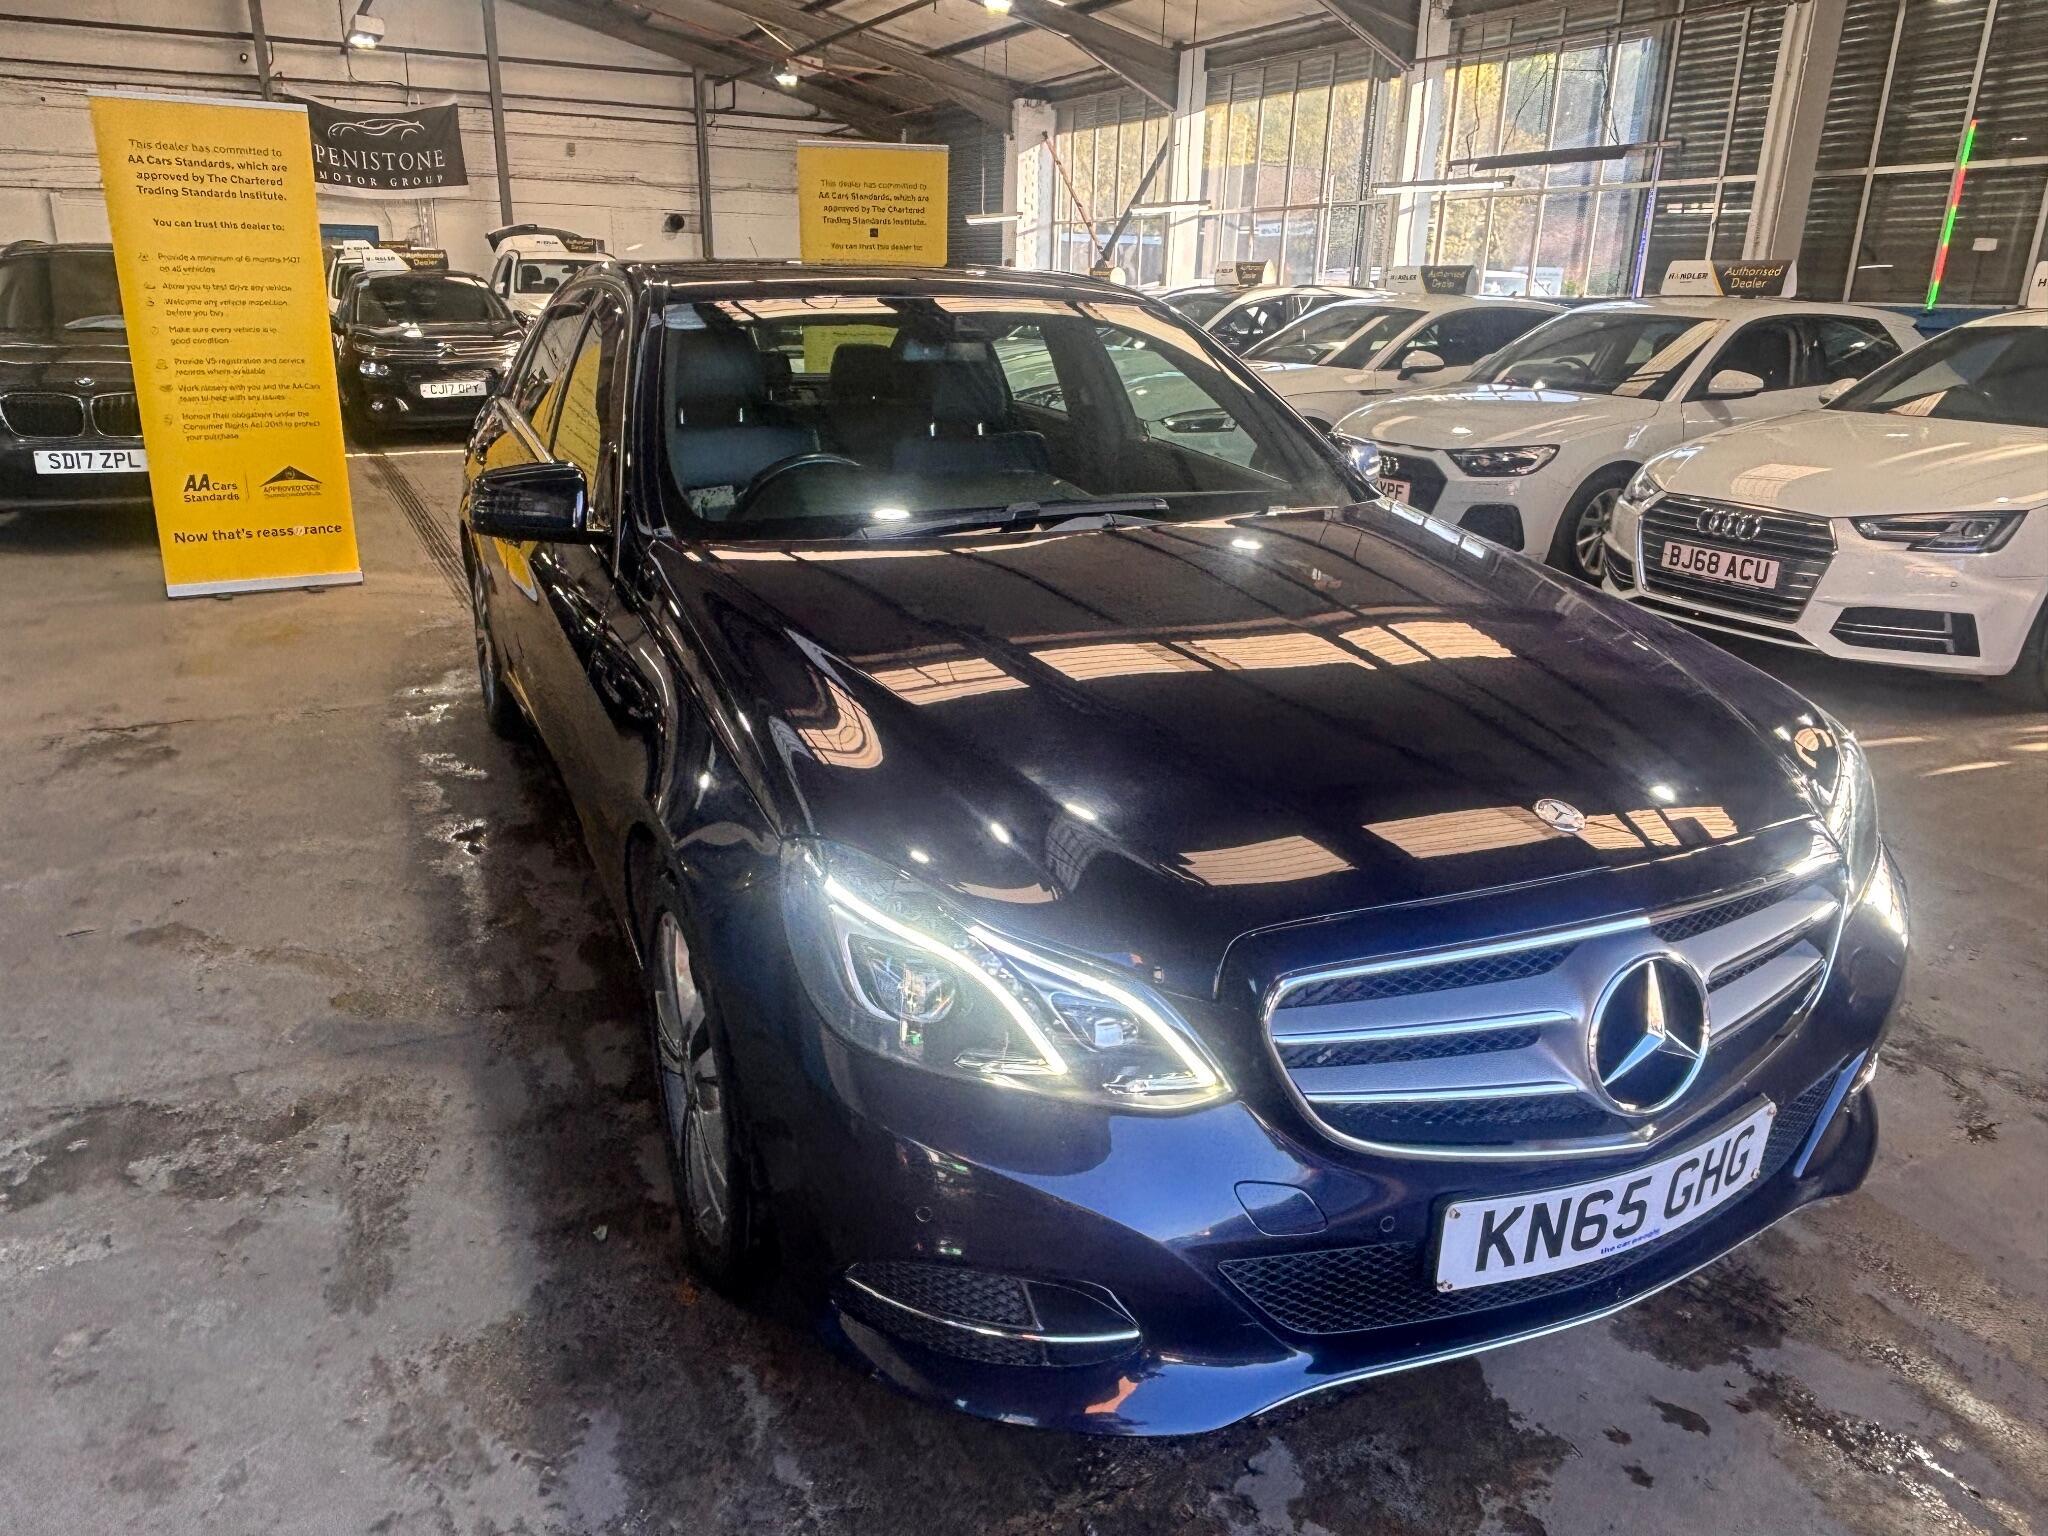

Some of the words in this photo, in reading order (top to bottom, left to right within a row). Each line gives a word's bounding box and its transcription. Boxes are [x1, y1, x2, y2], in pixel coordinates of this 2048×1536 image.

[128, 139, 152, 150] This
[155, 141, 189, 151] dealer
[192, 143, 210, 153] has
[214, 145, 269, 157] committed
[272, 149, 282, 157] to
[314, 144, 446, 171] PENISTONE
[128, 155, 144, 164] AA
[146, 155, 172, 165] Cars
[175, 157, 234, 170] Standards,
[237, 161, 268, 171] which
[271, 164, 288, 172] are
[136, 172, 189, 182] approved
[192, 173, 205, 184] by
[206, 174, 227, 183] The
[230, 175, 283, 186] Chartered
[319, 171, 377, 186] MOTOR
[390, 175, 443, 186] GROUP
[839, 180, 861, 188] dealer
[878, 182, 918, 190] committed
[136, 185, 178, 197] Trading
[181, 187, 237, 199] Standards
[240, 190, 287, 201] Institute.
[832, 192, 849, 200] Cars
[851, 193, 892, 201] Standards,
[894, 194, 915, 202] which
[824, 205, 859, 213] approved
[862, 206, 870, 214] by
[887, 206, 925, 214] Chartered
[153, 218, 172, 227] You
[194, 220, 217, 228] trust
[220, 221, 238, 229] this
[240, 222, 270, 230] dealer
[272, 223, 285, 231] to:
[822, 216, 851, 225] Trading
[852, 217, 891, 225] Standards
[831, 242, 844, 250] You
[158, 253, 188, 262] Provide
[1724, 265, 1784, 276] Authorised
[1731, 277, 1768, 288] Dealer
[170, 337, 190, 345] good
[219, 358, 261, 366] registration
[430, 384, 454, 394] CJ17
[184, 423, 223, 431] Consumer
[47, 452, 93, 469] SD17
[100, 452, 141, 468] ZPL
[184, 474, 211, 492] AA
[212, 482, 238, 491] Cars
[184, 492, 240, 503] Standards
[174, 532, 208, 544] Now
[212, 528, 253, 541] that's
[1668, 545, 1721, 574] BJ68
[1724, 555, 1770, 584] ACU
[1474, 1175, 1653, 1272] KN65
[1663, 1125, 1756, 1221] GHG
